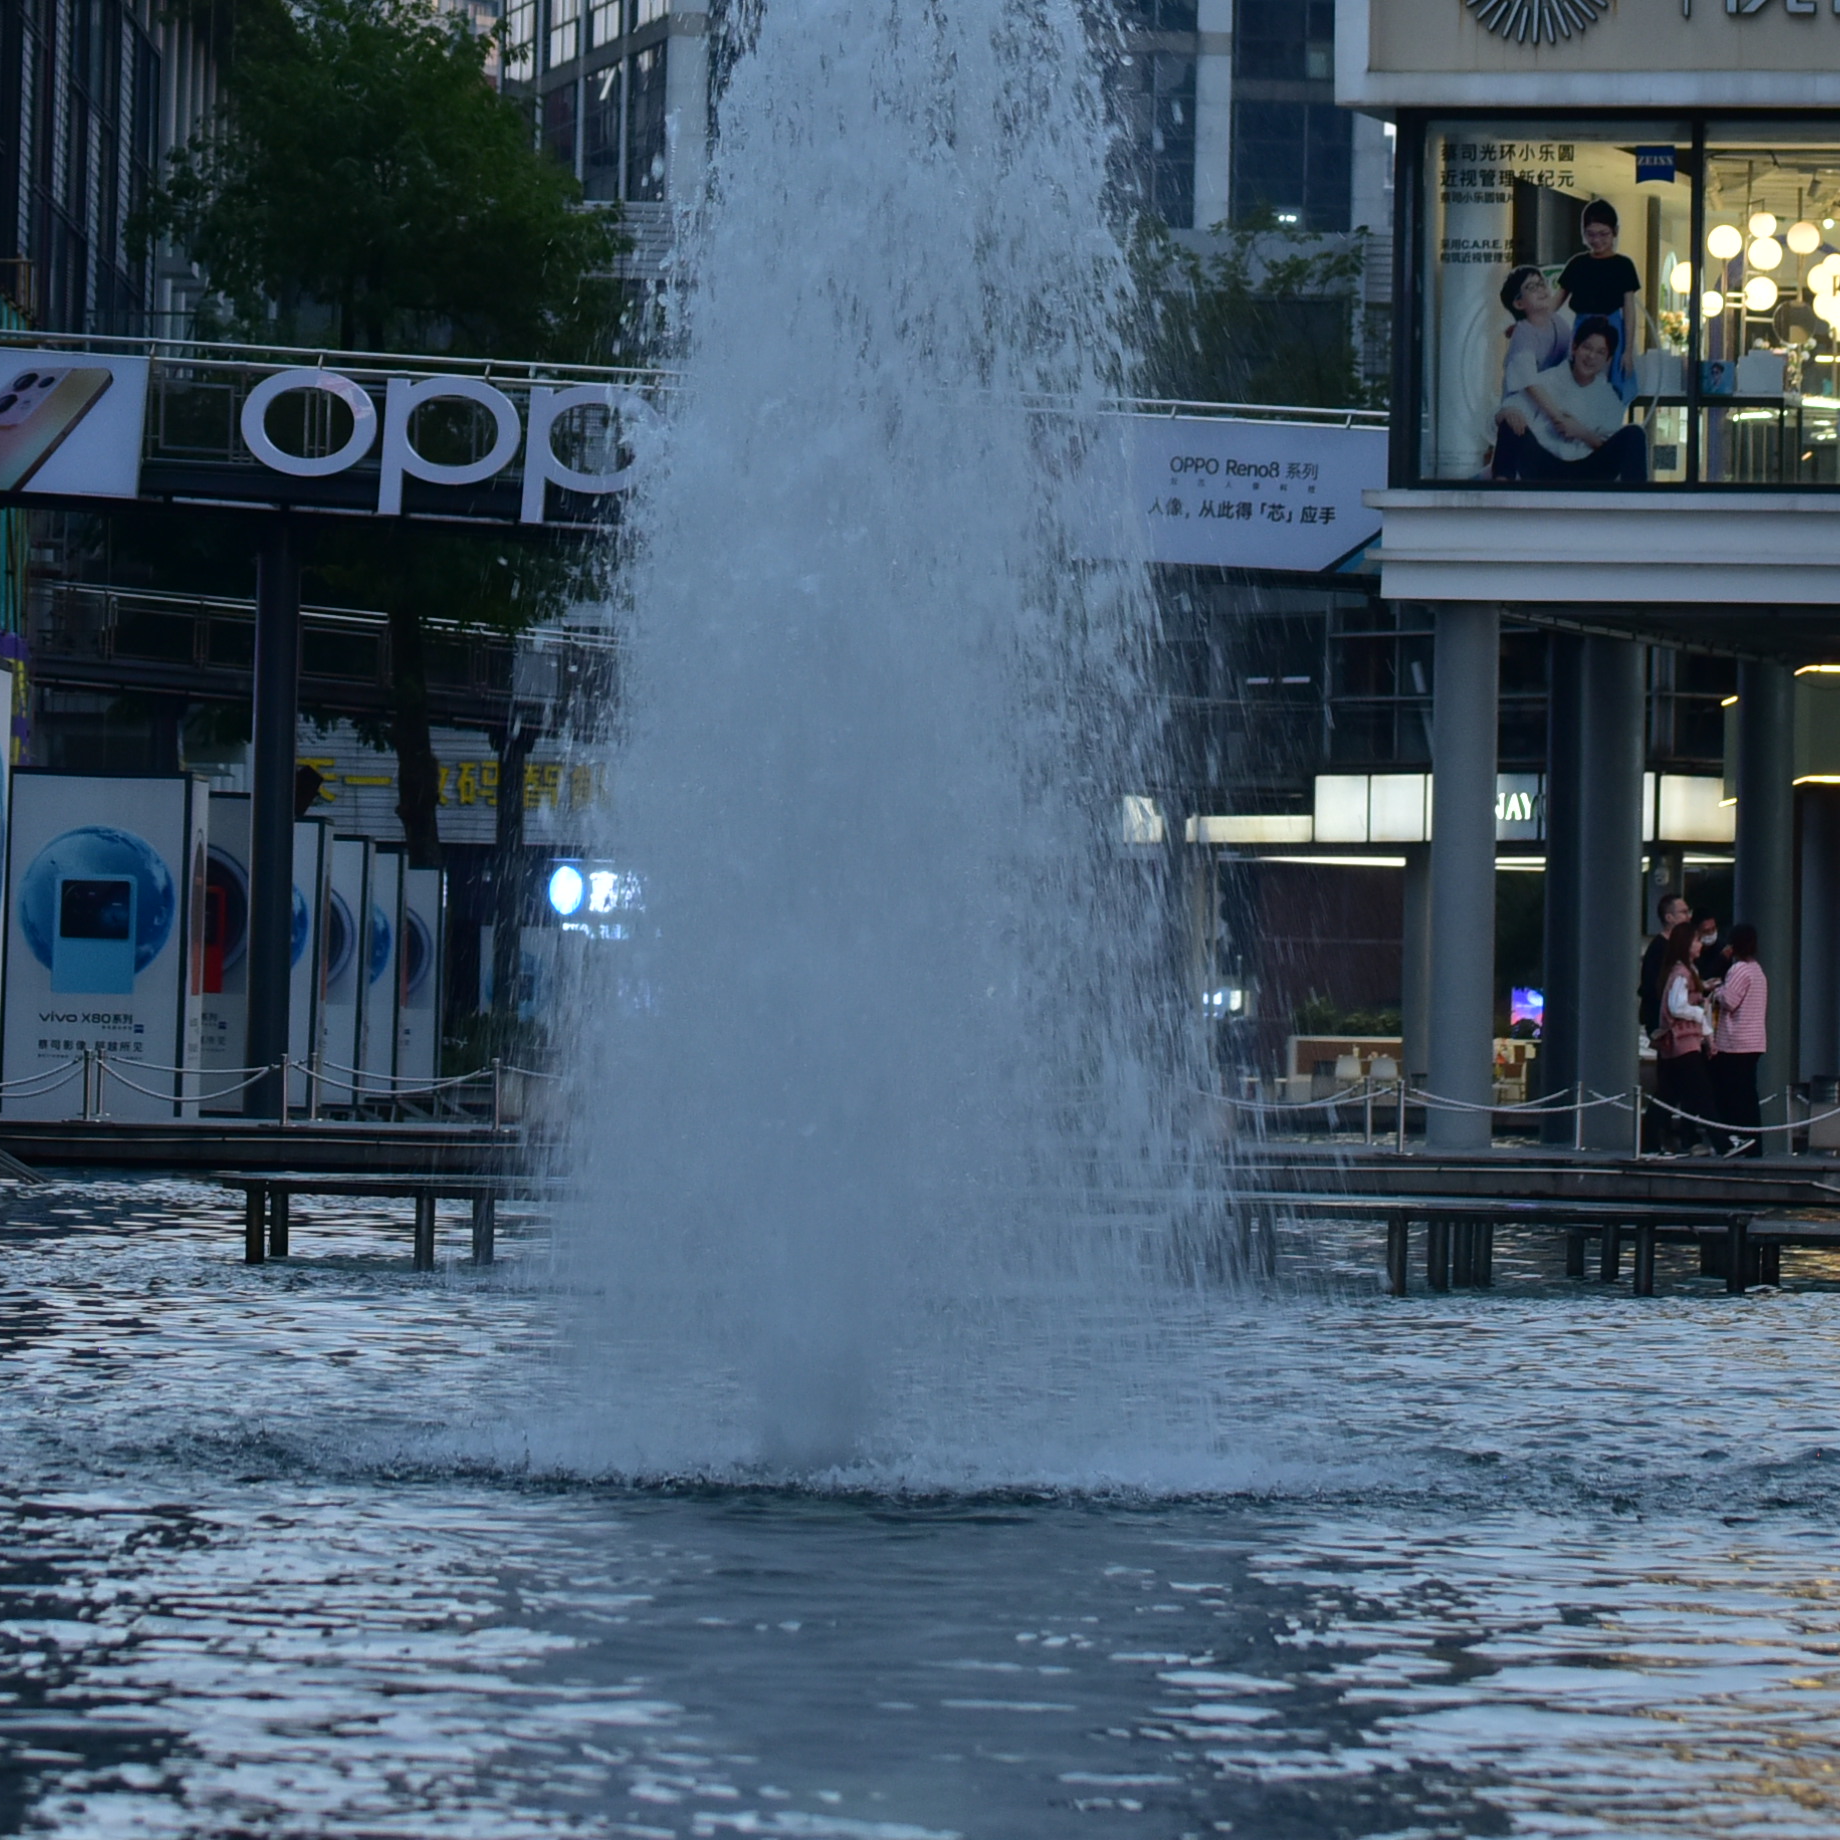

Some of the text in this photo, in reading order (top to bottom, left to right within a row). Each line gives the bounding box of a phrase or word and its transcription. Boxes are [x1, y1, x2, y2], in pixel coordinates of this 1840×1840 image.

[1441, 144, 1575, 162] 蔡司光环小乐圆
[1637, 155, 1675, 166] ZEISS
[1440, 169, 1575, 188] 近视管理新纪元
[1170, 456, 1319, 480] OPPO Reno8 系列
[39, 1010, 133, 1025] vivo X80系列
